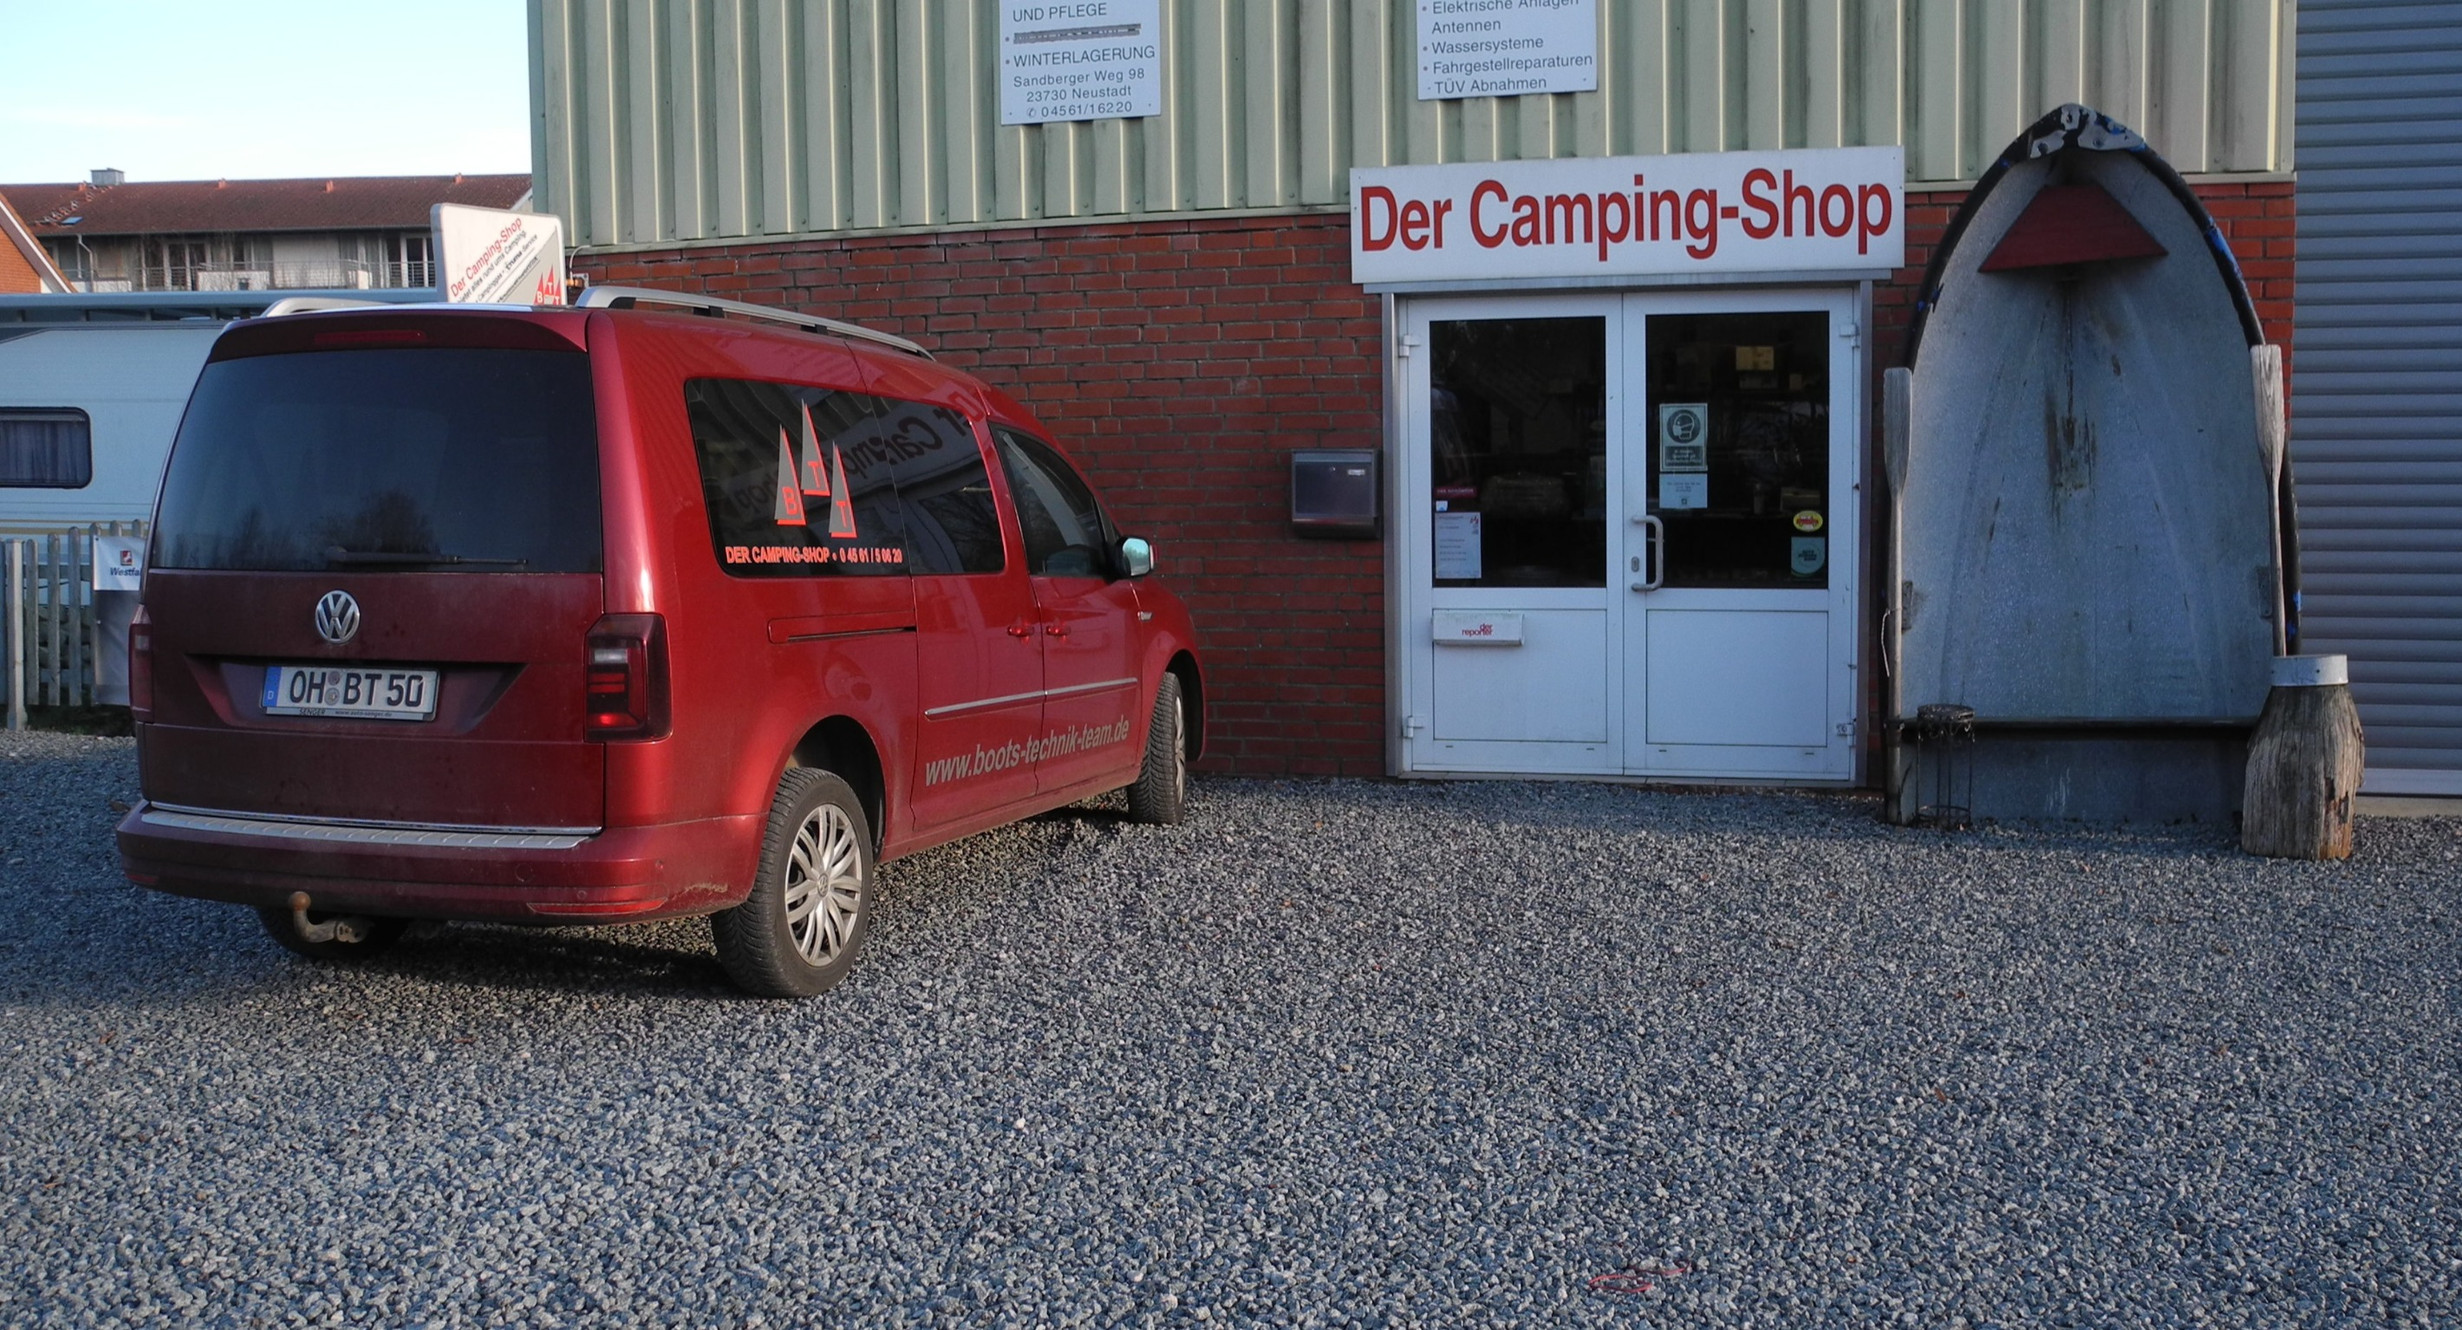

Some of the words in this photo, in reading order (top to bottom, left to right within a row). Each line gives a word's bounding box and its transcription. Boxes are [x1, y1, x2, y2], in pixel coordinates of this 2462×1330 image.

[1012, 8, 1044, 22] UND
[1049, 2, 1107, 20] PFLEGE
[1433, 0, 1513, 14] Elektrische
[1432, 20, 1501, 34] Antennen
[1432, 37, 1544, 54] Wassersysteme
[1013, 45, 1155, 67] WINTERLAGERUNG
[1433, 55, 1592, 76] Fahrgestellreparaturen
[1013, 72, 1090, 88] Sandberger
[1094, 70, 1123, 83] Weg
[1129, 68, 1145, 80] 98
[1435, 78, 1466, 94] TÜV
[1470, 77, 1547, 92] Abnahmen
[1026, 89, 1067, 103] 23730
[1072, 85, 1132, 100] Neustadt
[1041, 101, 1132, 118] 04561/16220
[1360, 185, 1452, 252] Der
[1469, 167, 1892, 262] Camping-Shop
[450, 278, 466, 298] Der
[465, 217, 523, 280] Camping-Shop
[725, 546, 751, 563] DER
[752, 546, 830, 563] CAMPING-SHOP
[840, 547, 846, 563] 0
[847, 547, 858, 563] 45
[110, 567, 142, 576] Westfa
[1462, 628, 1493, 637] reporter
[290, 670, 326, 703] OH
[343, 672, 382, 705] BT
[387, 674, 424, 707] 50
[299, 708, 326, 716] SENGER
[926, 714, 1130, 787] www.boots-technik-team.de
